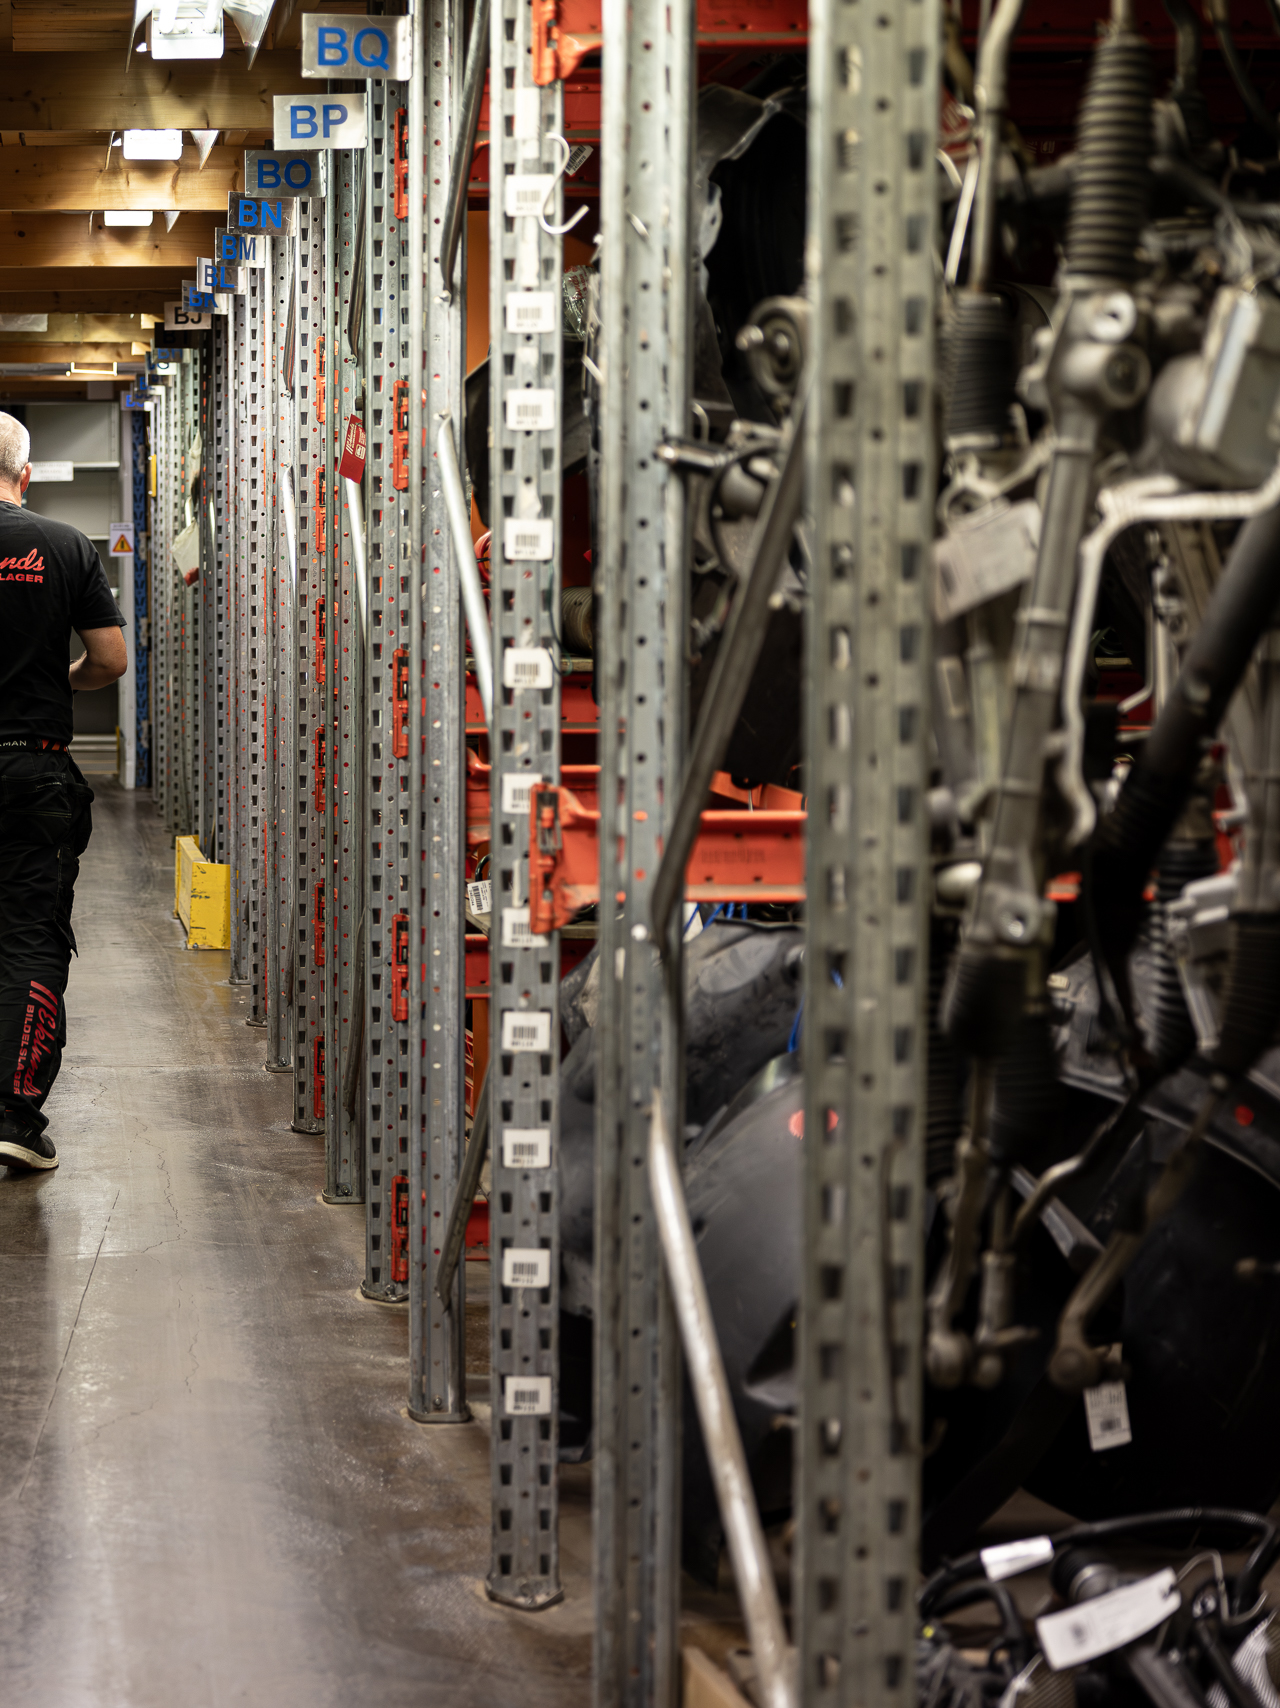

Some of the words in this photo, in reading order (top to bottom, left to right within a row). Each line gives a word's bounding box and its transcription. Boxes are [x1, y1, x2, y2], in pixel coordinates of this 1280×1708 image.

[317, 26, 390, 72] BQ
[289, 104, 348, 139] BP
[257, 159, 312, 190] BO
[238, 199, 282, 229] BN
[222, 235, 256, 261] BM
[204, 264, 235, 289] BL
[188, 286, 219, 308] BK
[174, 307, 202, 325] BJ
[13, 1004, 35, 1095] BILDELSLAGER
[23, 1006, 57, 1097] Eklunds
